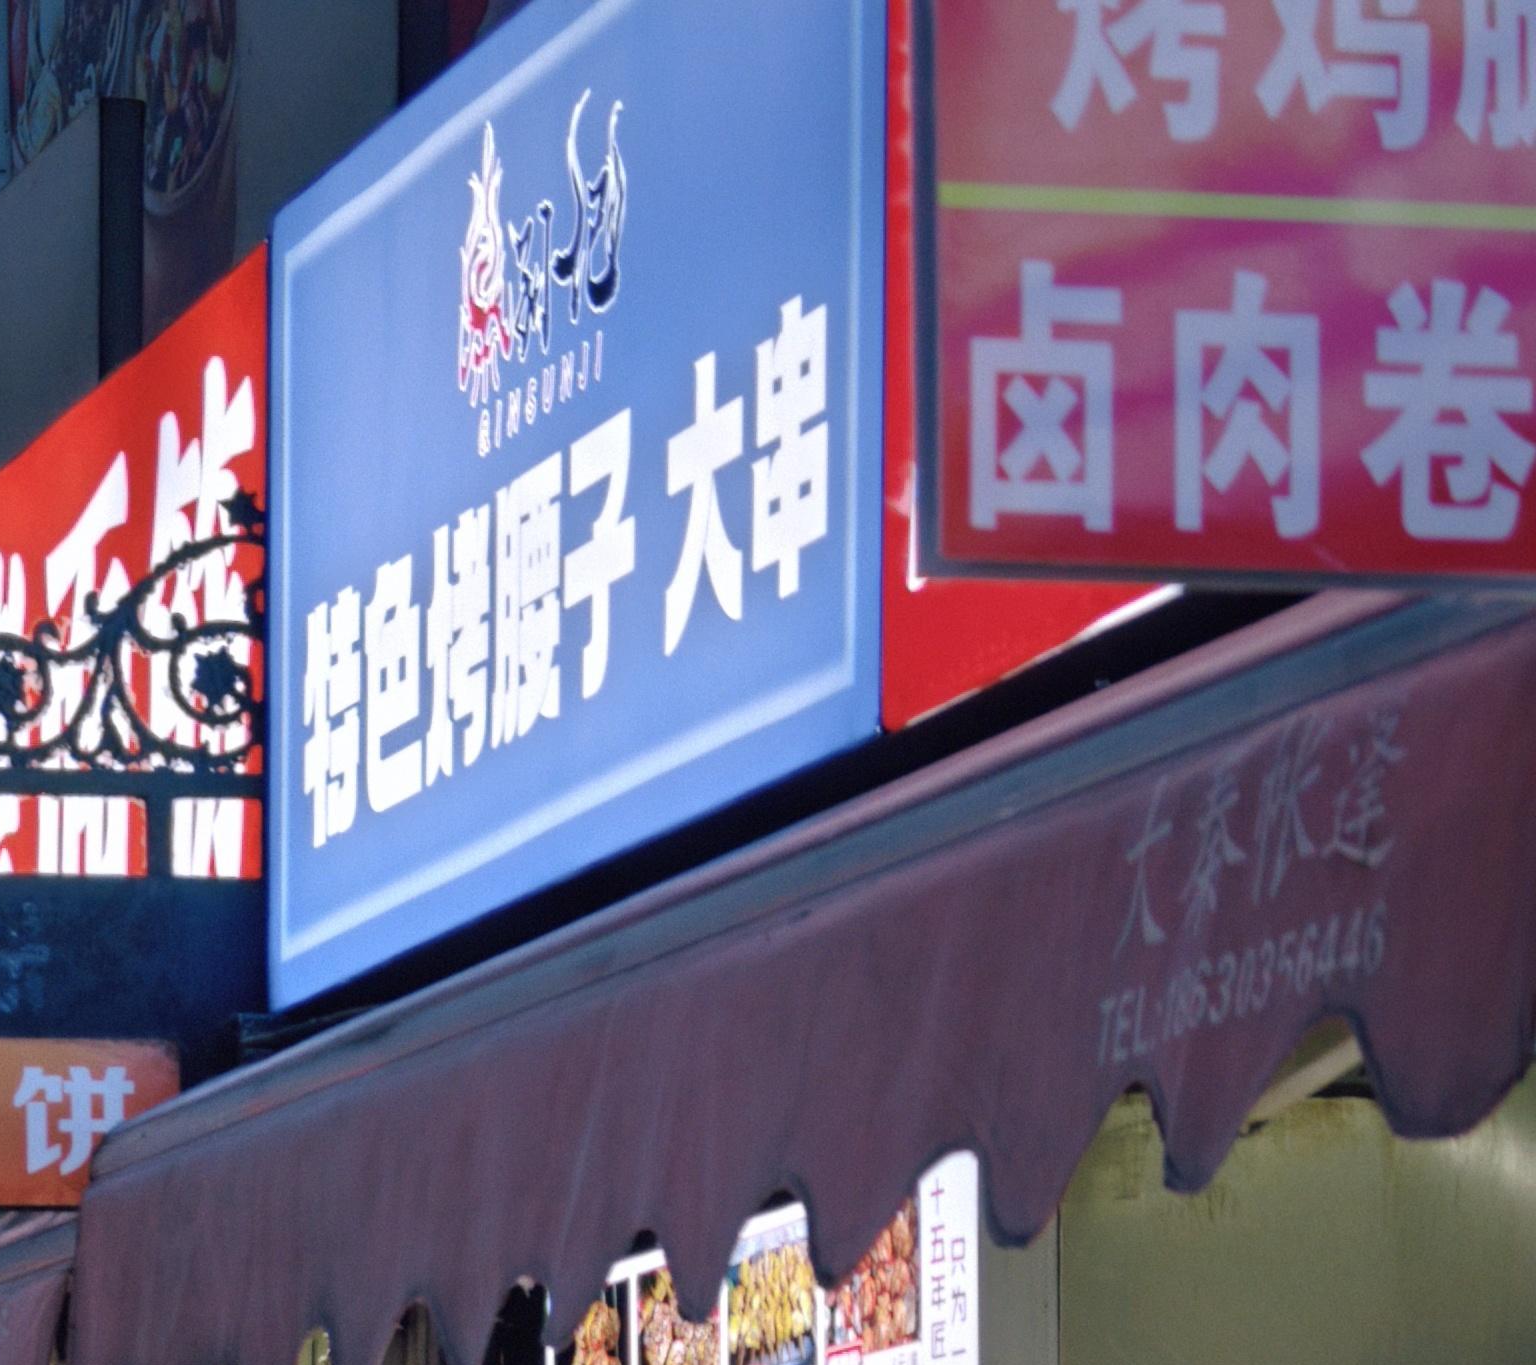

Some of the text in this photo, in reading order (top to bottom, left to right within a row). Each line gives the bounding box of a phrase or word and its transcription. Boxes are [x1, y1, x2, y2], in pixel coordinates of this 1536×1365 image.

[303, 406, 637, 850] 特色烤腰子
[663, 295, 829, 658] 大串
[967, 259, 1536, 541] 卤肉卷
